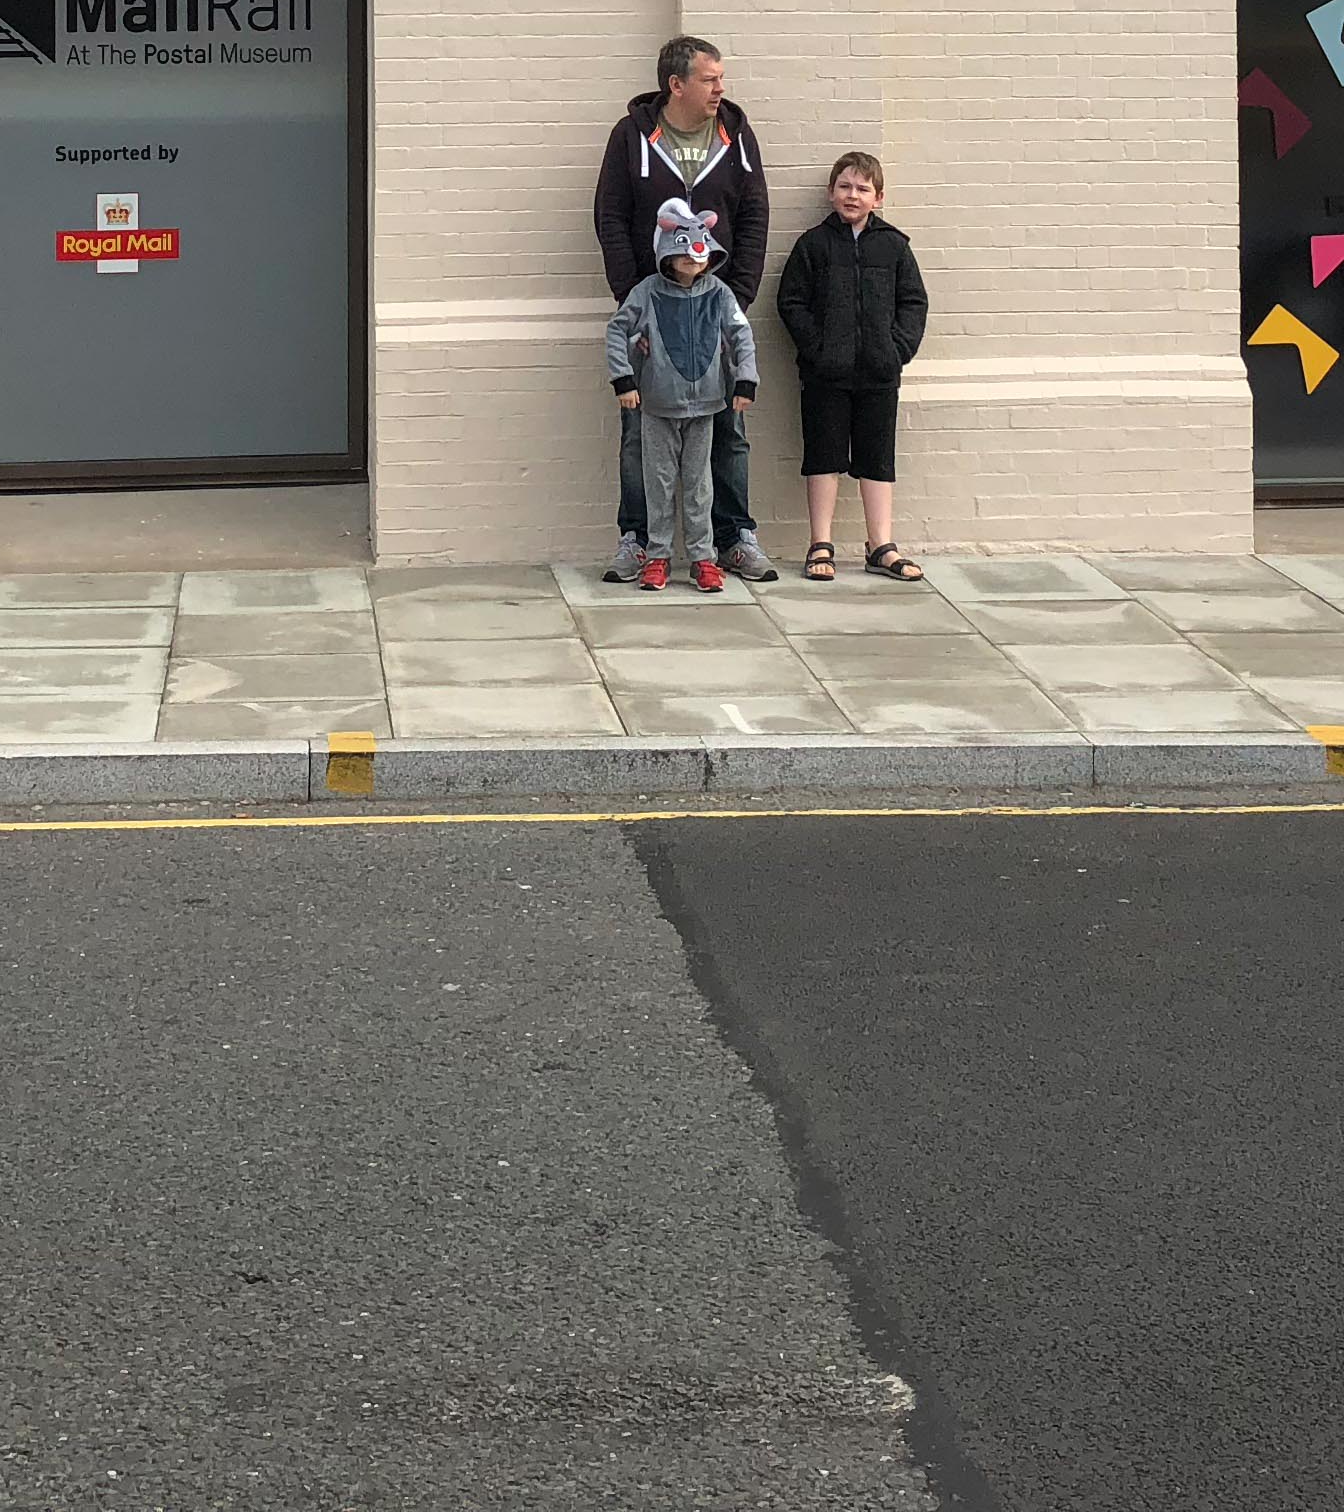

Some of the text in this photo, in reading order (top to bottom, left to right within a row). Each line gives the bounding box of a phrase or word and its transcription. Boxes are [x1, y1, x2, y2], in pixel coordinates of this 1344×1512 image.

[66, 43, 312, 65] At The Postal Museum
[56, 144, 179, 165] Supported by
[63, 234, 172, 257] Royal Mail
